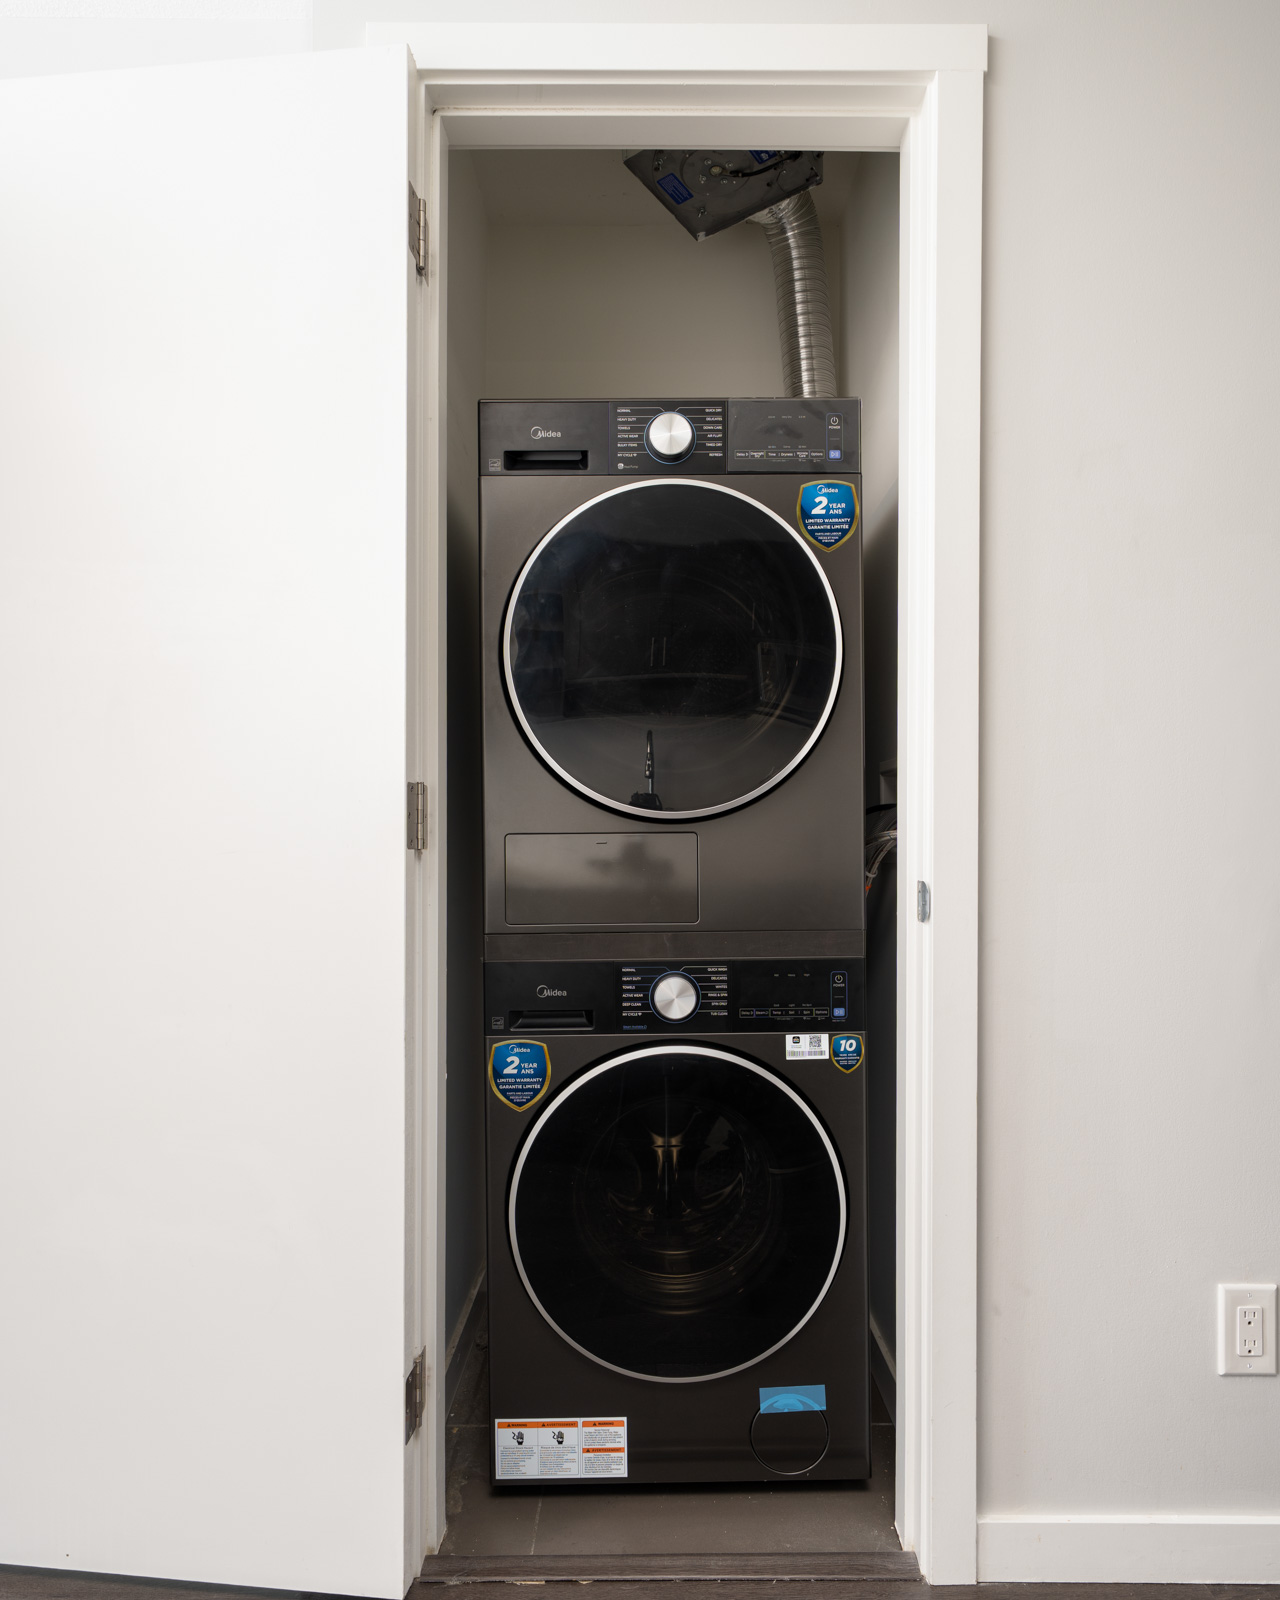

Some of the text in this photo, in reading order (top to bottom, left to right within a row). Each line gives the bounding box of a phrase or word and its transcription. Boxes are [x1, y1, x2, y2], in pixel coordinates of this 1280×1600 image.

[530, 426, 562, 440] Midea
[817, 485, 838, 494] Midea
[811, 496, 828, 514] 2
[536, 984, 567, 998] Midea
[509, 1045, 530, 1054] Midea
[840, 1039, 856, 1052] 10
[503, 1056, 520, 1074] 2
